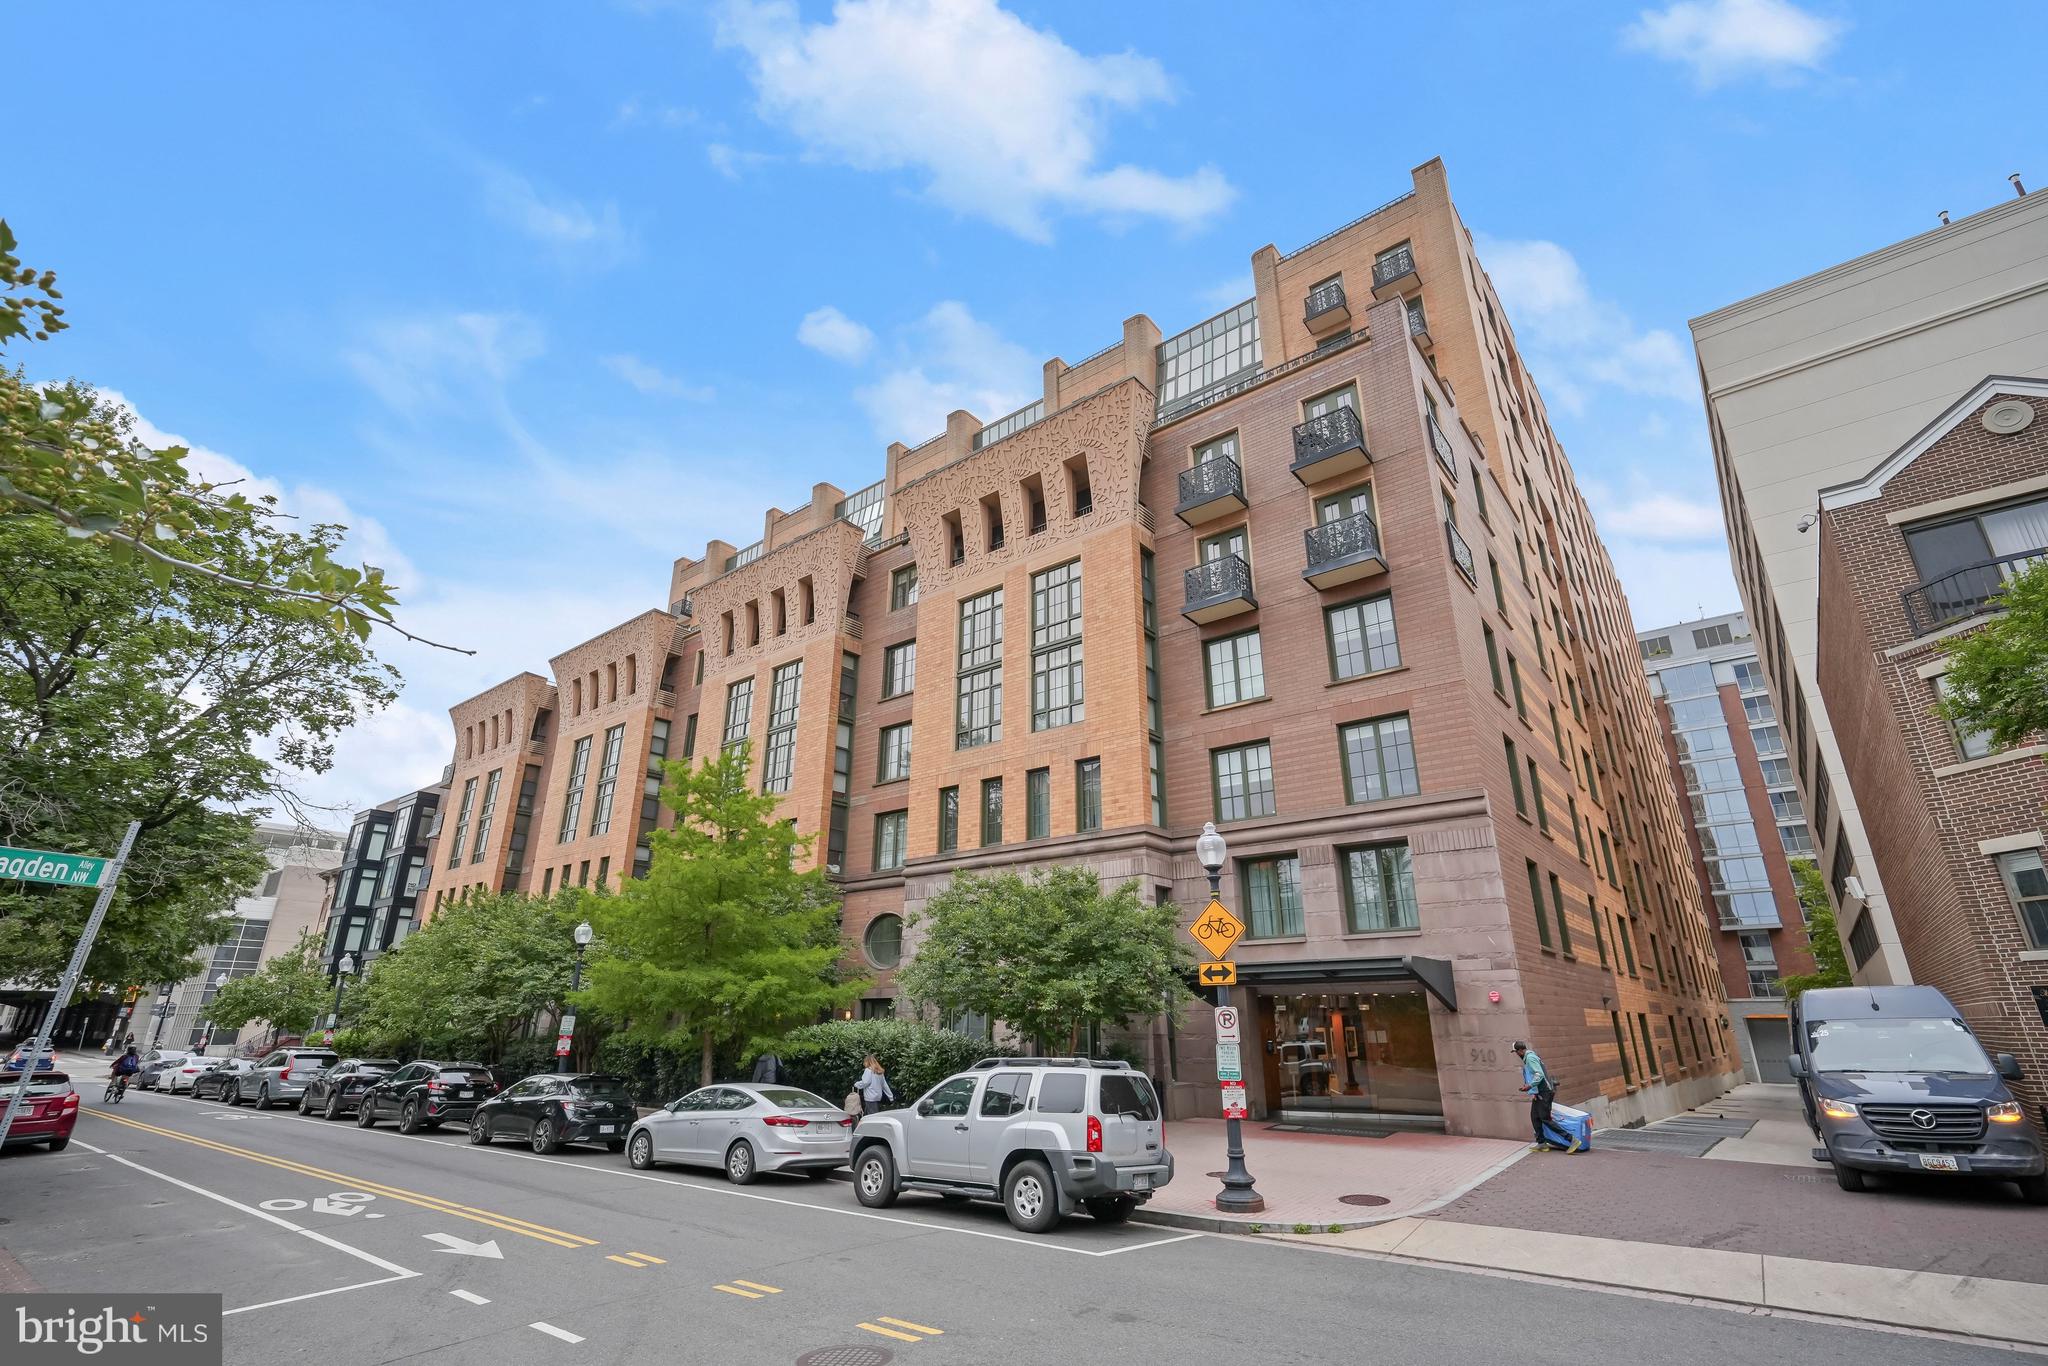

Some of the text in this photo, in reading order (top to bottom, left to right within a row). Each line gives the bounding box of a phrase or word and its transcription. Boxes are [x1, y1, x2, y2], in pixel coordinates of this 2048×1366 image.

[79, 860, 96, 870] Alley
[71, 870, 89, 883] NW
[1470, 1048, 1497, 1063] 910
